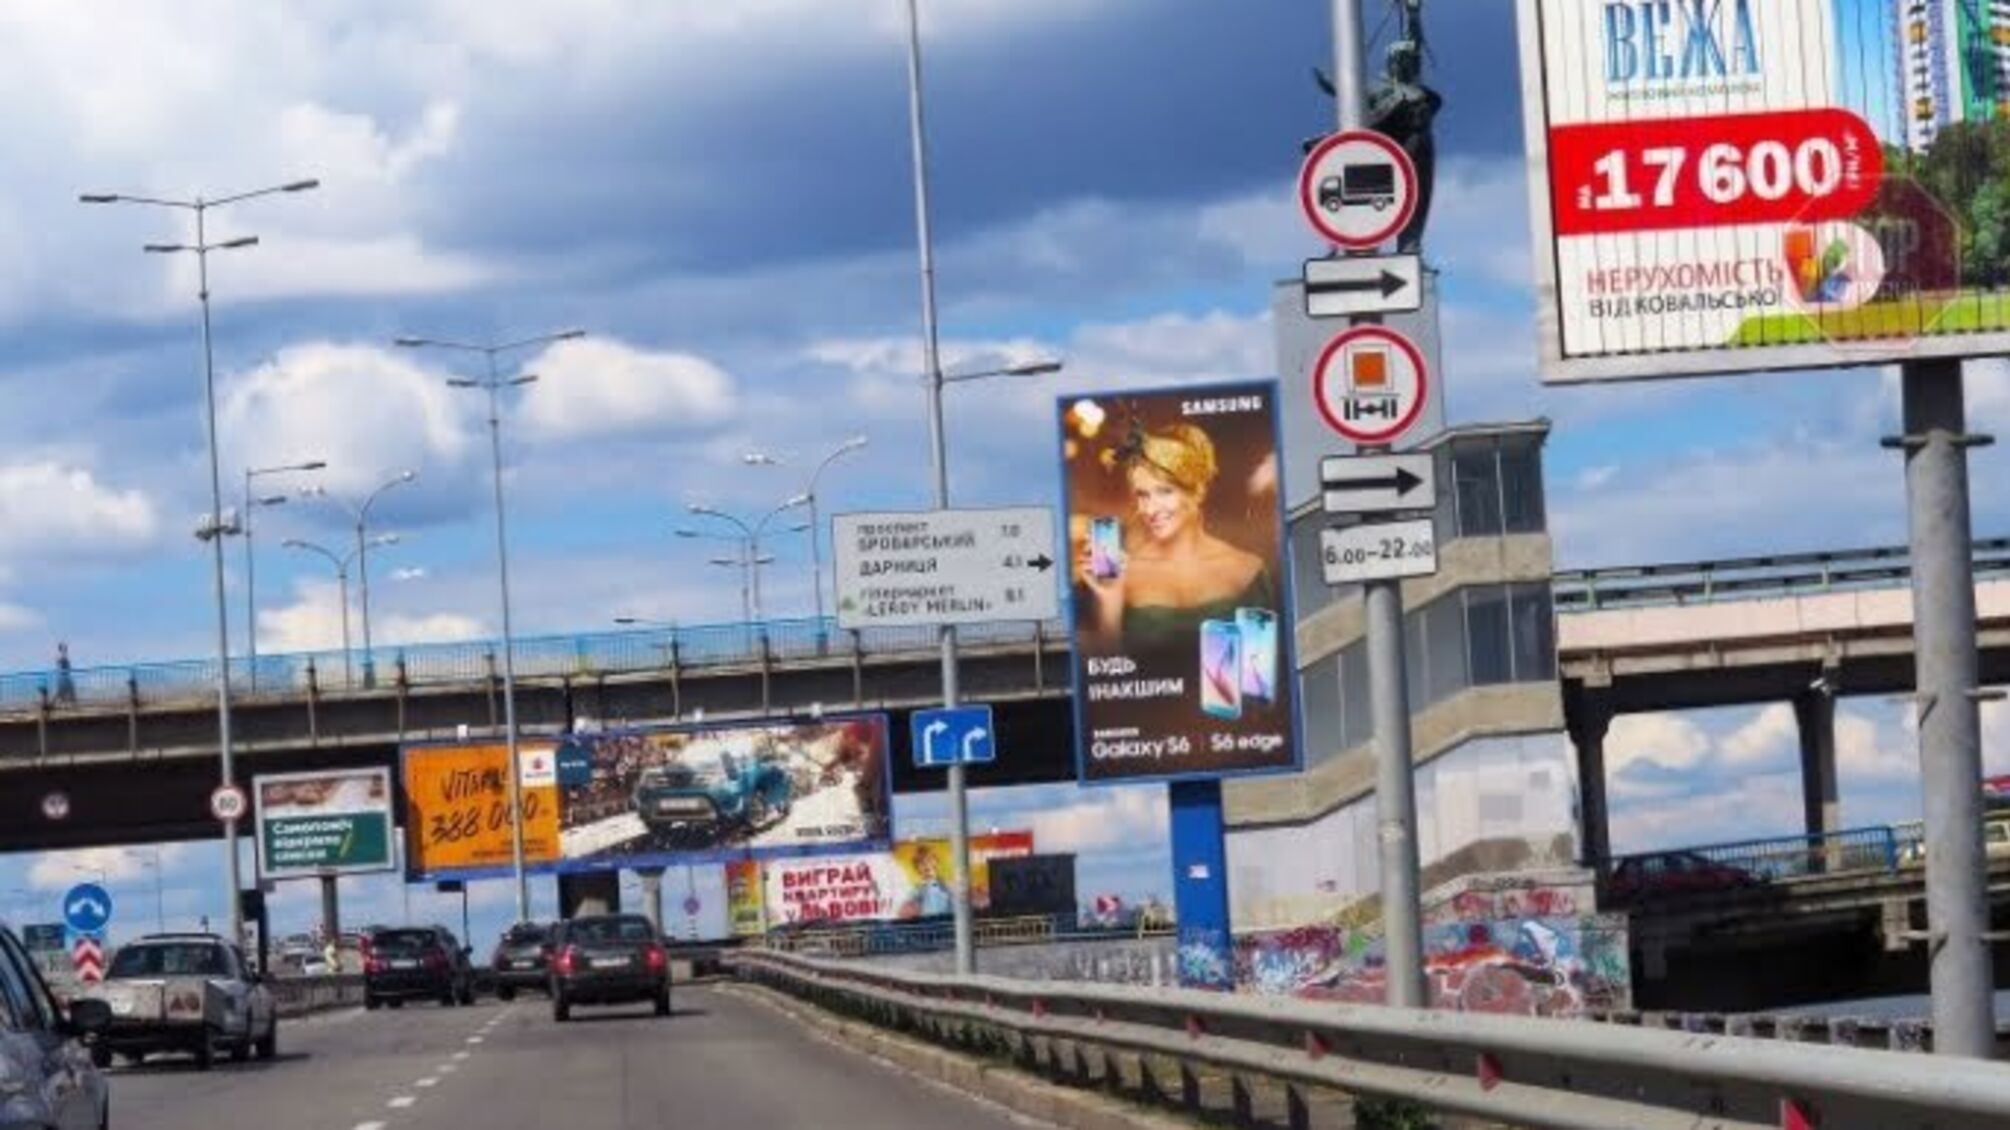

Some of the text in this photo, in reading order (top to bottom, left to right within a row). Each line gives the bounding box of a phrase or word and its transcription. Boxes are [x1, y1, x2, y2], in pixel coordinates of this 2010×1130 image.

[1605, 0, 1759, 82] ВЕЖА
[1593, 136, 1844, 211] 17 600
[1586, 257, 1784, 295] НЕРУХОМІСТЬ
[1589, 286, 1785, 319] ВІД КОВАЛЬСЬКОЇ
[1181, 395, 1262, 416] SAMSUNG
[859, 557, 938, 577] ДАРНИЦЯ
[1087, 656, 1137, 676] БУДЬ
[1088, 677, 1185, 700] ІНАКШИМ
[1091, 732, 1284, 760] Galaxy S6 S6 edge
[782, 862, 872, 888] ВИГРАЙ
[783, 885, 871, 903] КВАРТИРУ
